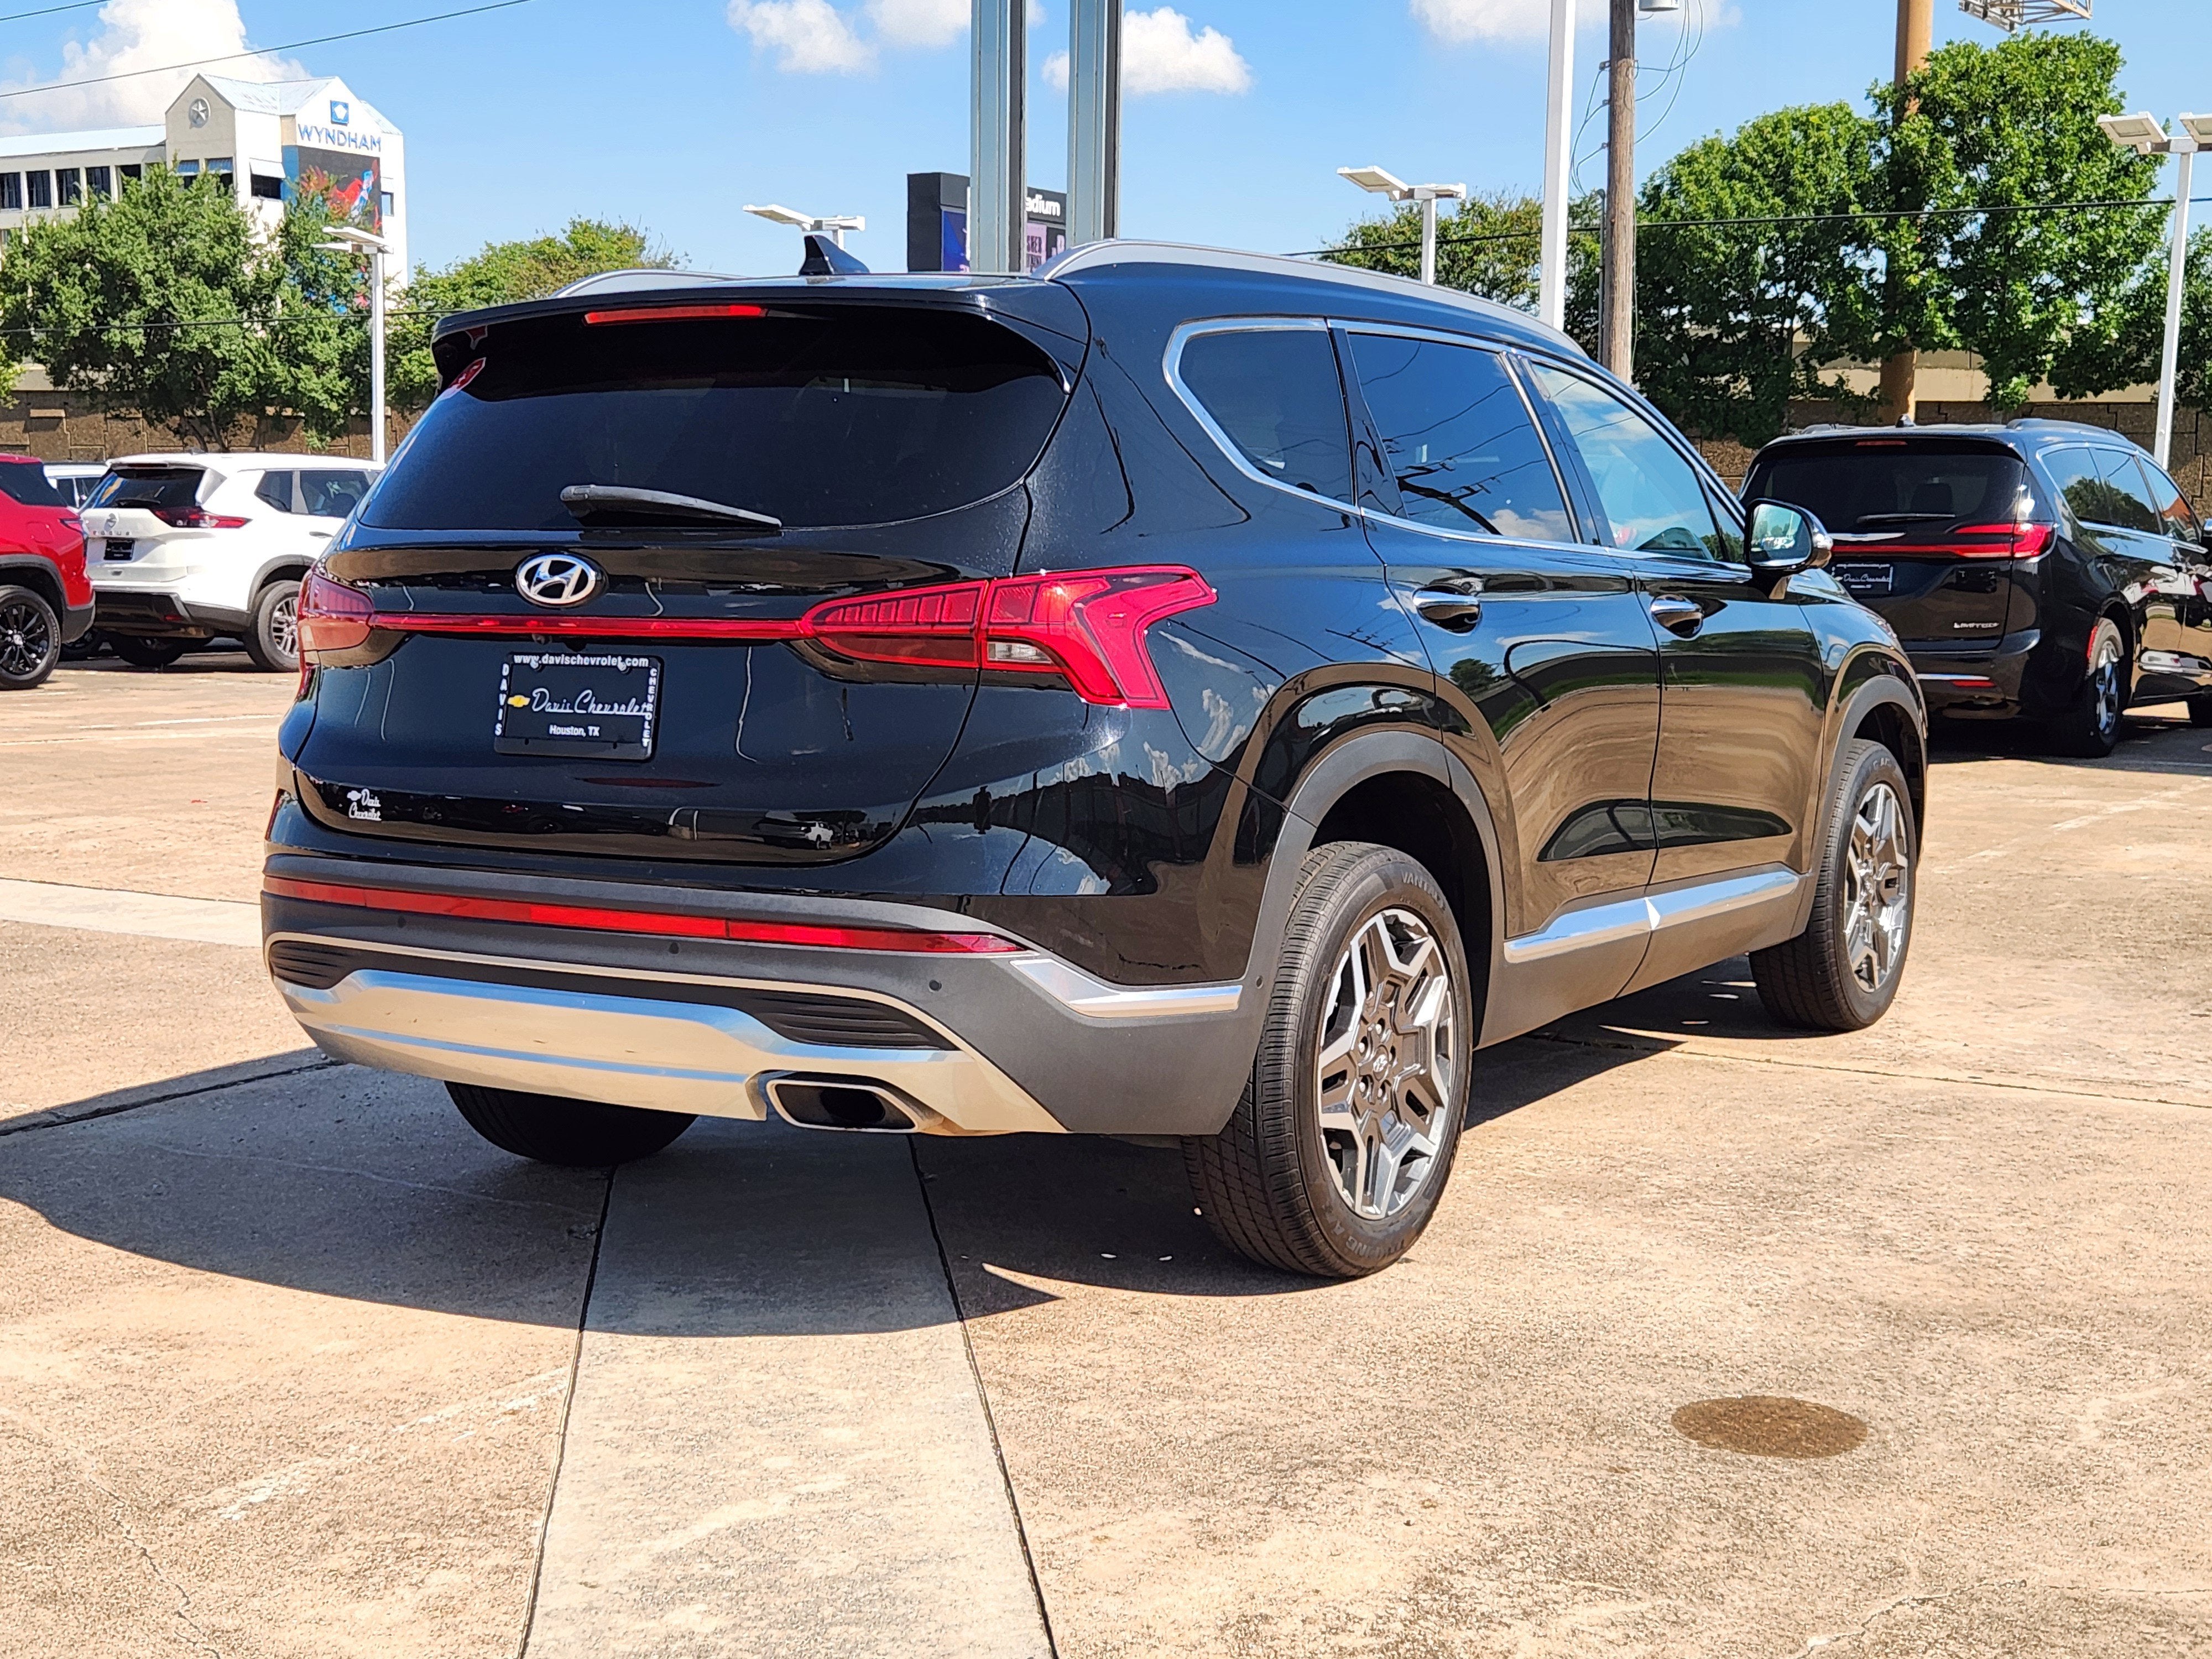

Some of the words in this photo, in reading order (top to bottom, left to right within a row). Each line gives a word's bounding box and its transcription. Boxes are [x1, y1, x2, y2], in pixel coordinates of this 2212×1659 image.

[298, 123, 381, 152] WYNDHAM
[513, 653, 649, 667] www.davischevroletcom
[495, 664, 509, 736] DAVIS
[531, 687, 574, 713] Davis
[574, 690, 647, 716] Chevrolet
[642, 667, 658, 747] CHEVROLET
[549, 724, 587, 738] Houston,
[587, 726, 601, 737] TX
